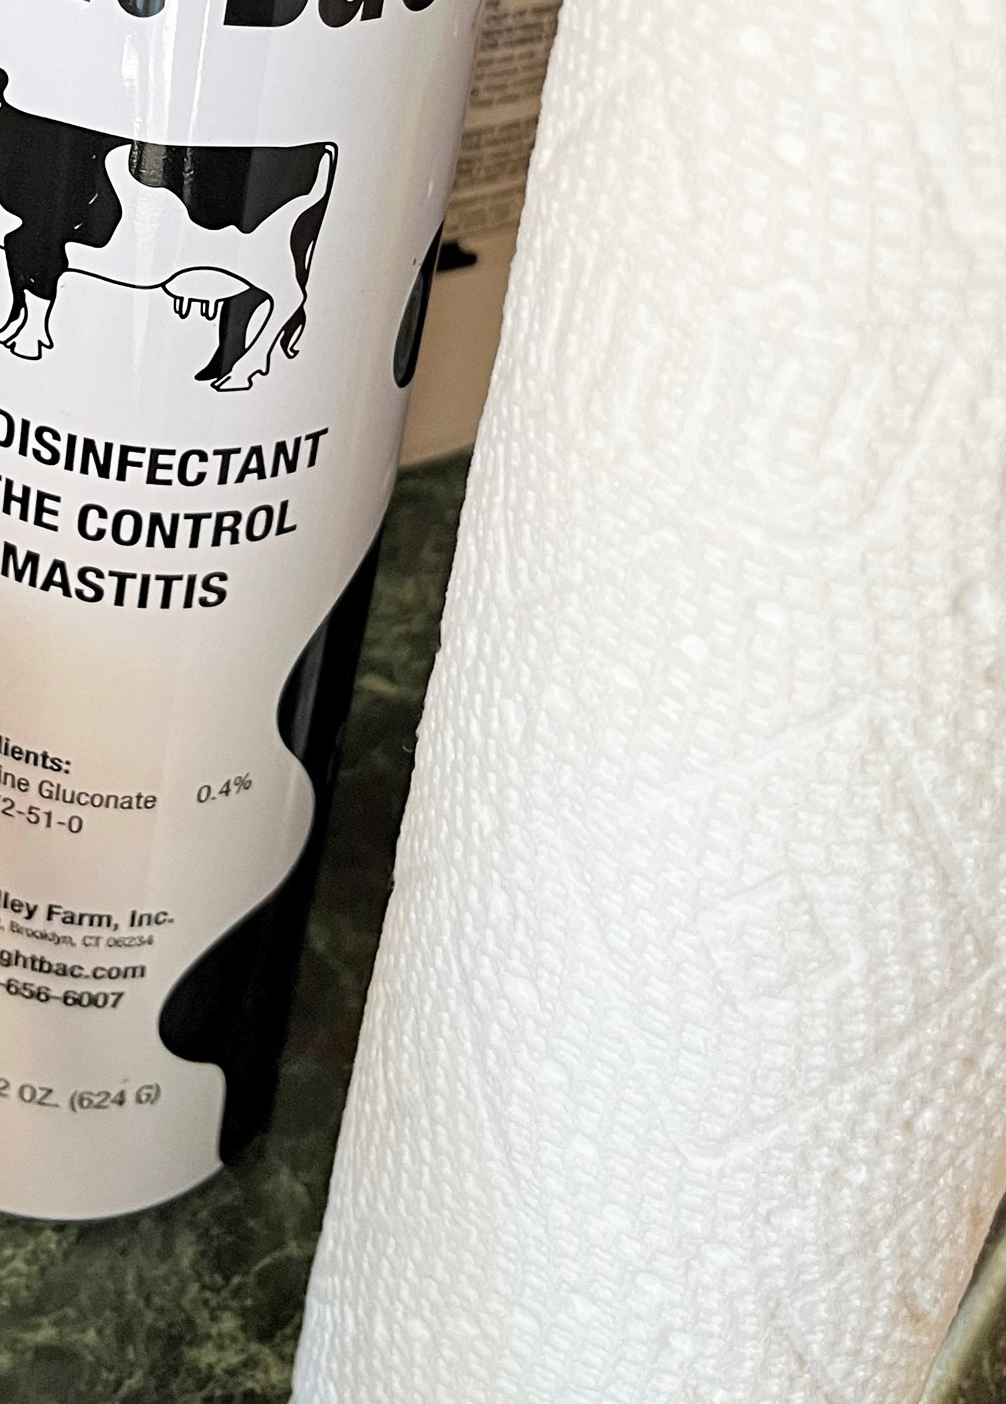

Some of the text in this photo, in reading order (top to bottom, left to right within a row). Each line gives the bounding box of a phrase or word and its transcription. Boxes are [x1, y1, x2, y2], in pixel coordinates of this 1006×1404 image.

[77, 499, 297, 550] CONTROL
[1, 541, 229, 610] MASTITIS
[38, 779, 158, 810] Gluconate
[196, 771, 253, 804] 0.4%
[46, 905, 120, 931] Farm,
[129, 910, 175, 928] Inc.
[69, 1088, 127, 1113] (624
[135, 1083, 161, 1106] G)
